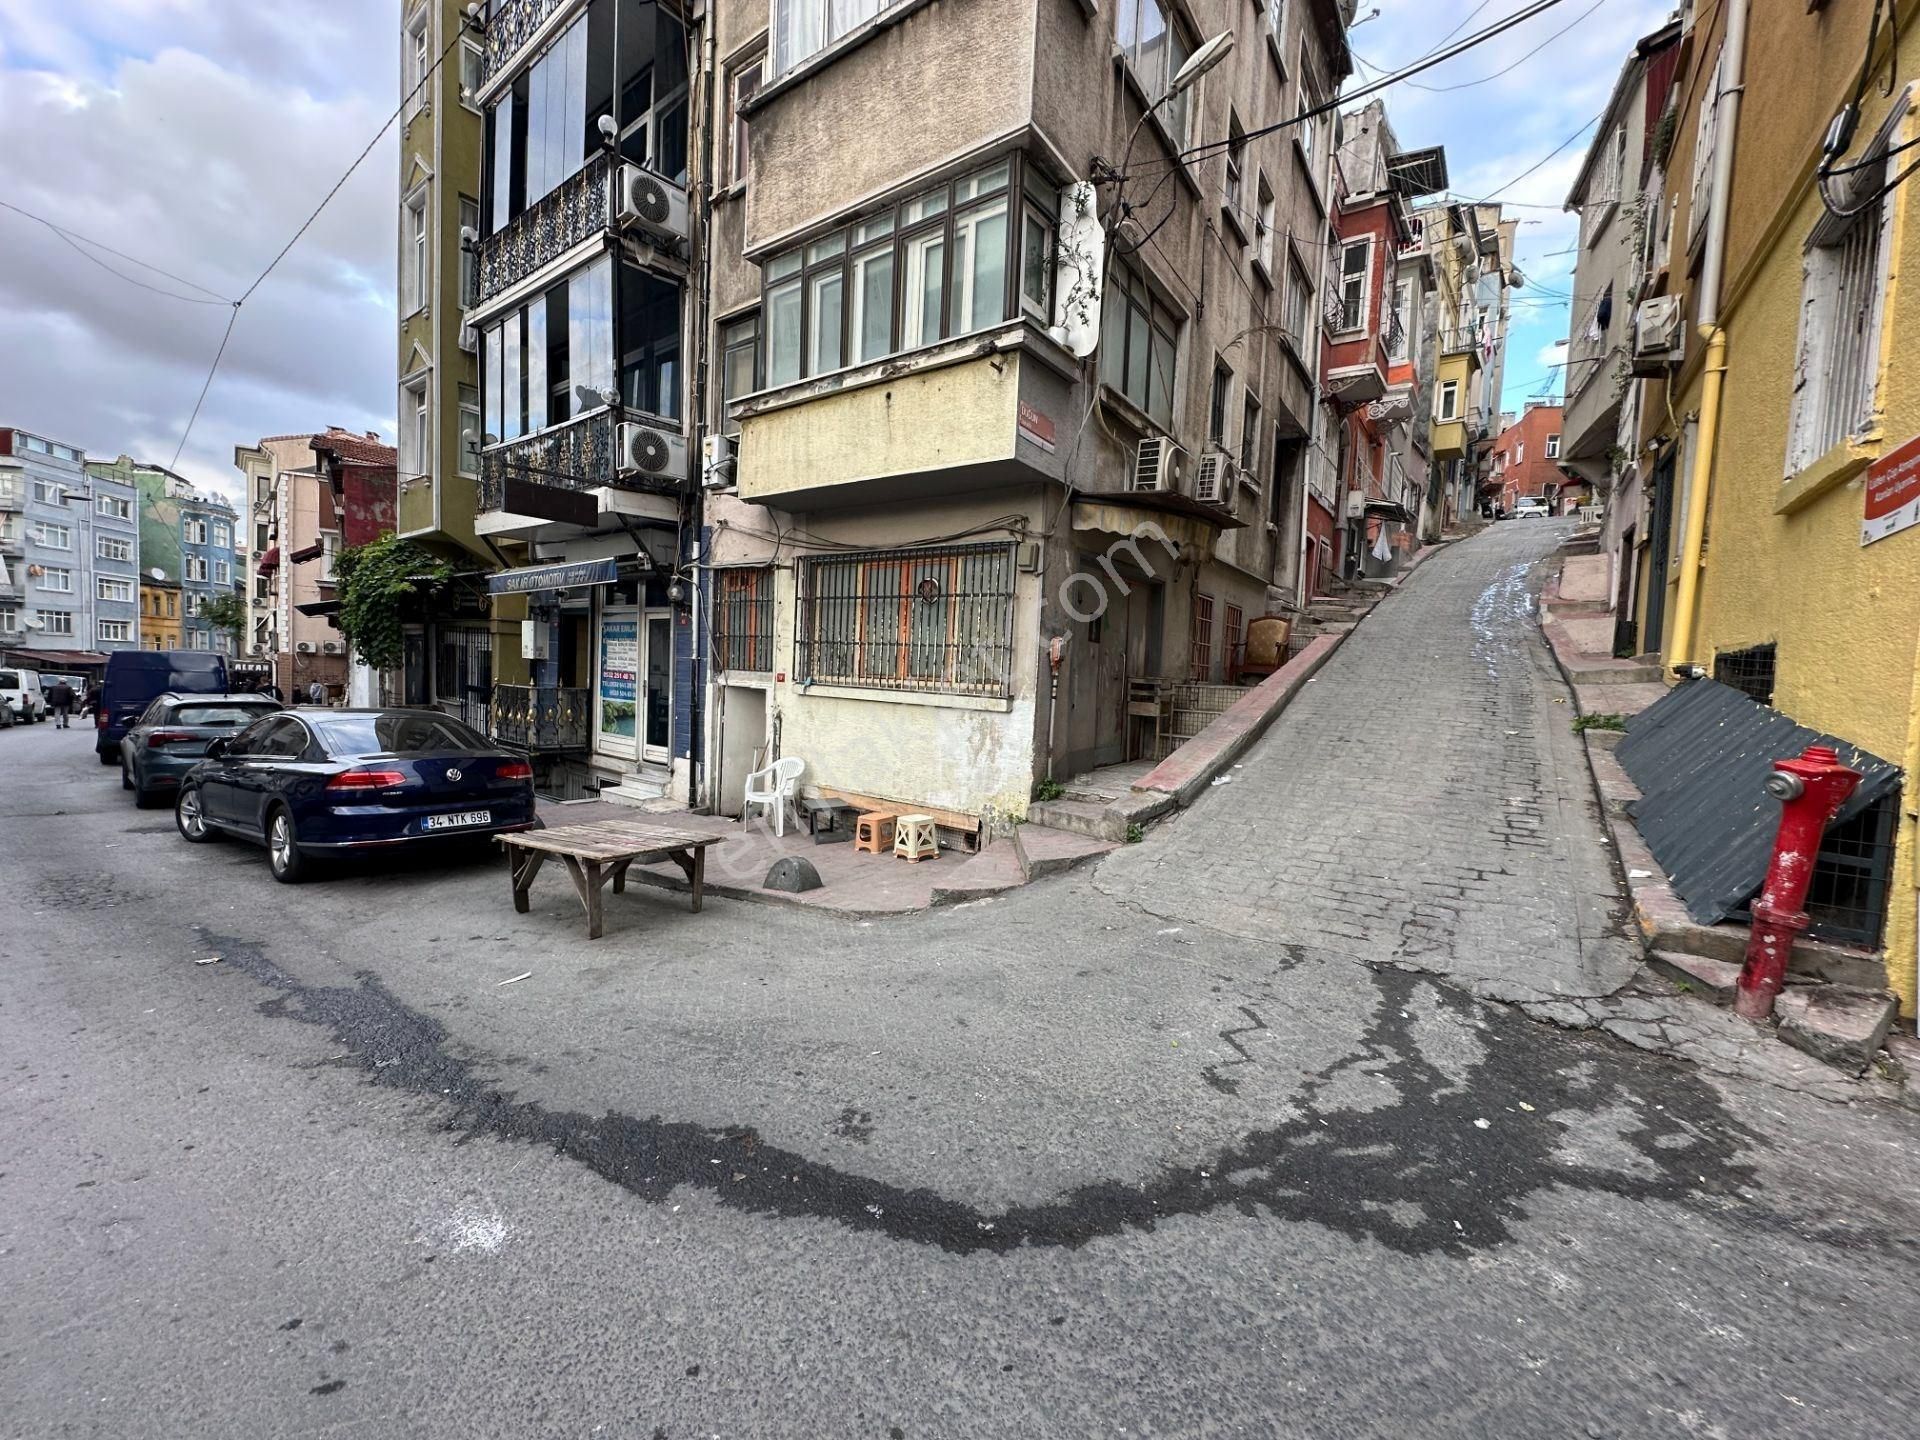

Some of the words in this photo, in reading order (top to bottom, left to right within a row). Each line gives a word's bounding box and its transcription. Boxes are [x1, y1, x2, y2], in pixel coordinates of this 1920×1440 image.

[429, 816, 443, 828] 34
[447, 813, 467, 825] NTK
[470, 811, 489, 823] 696
